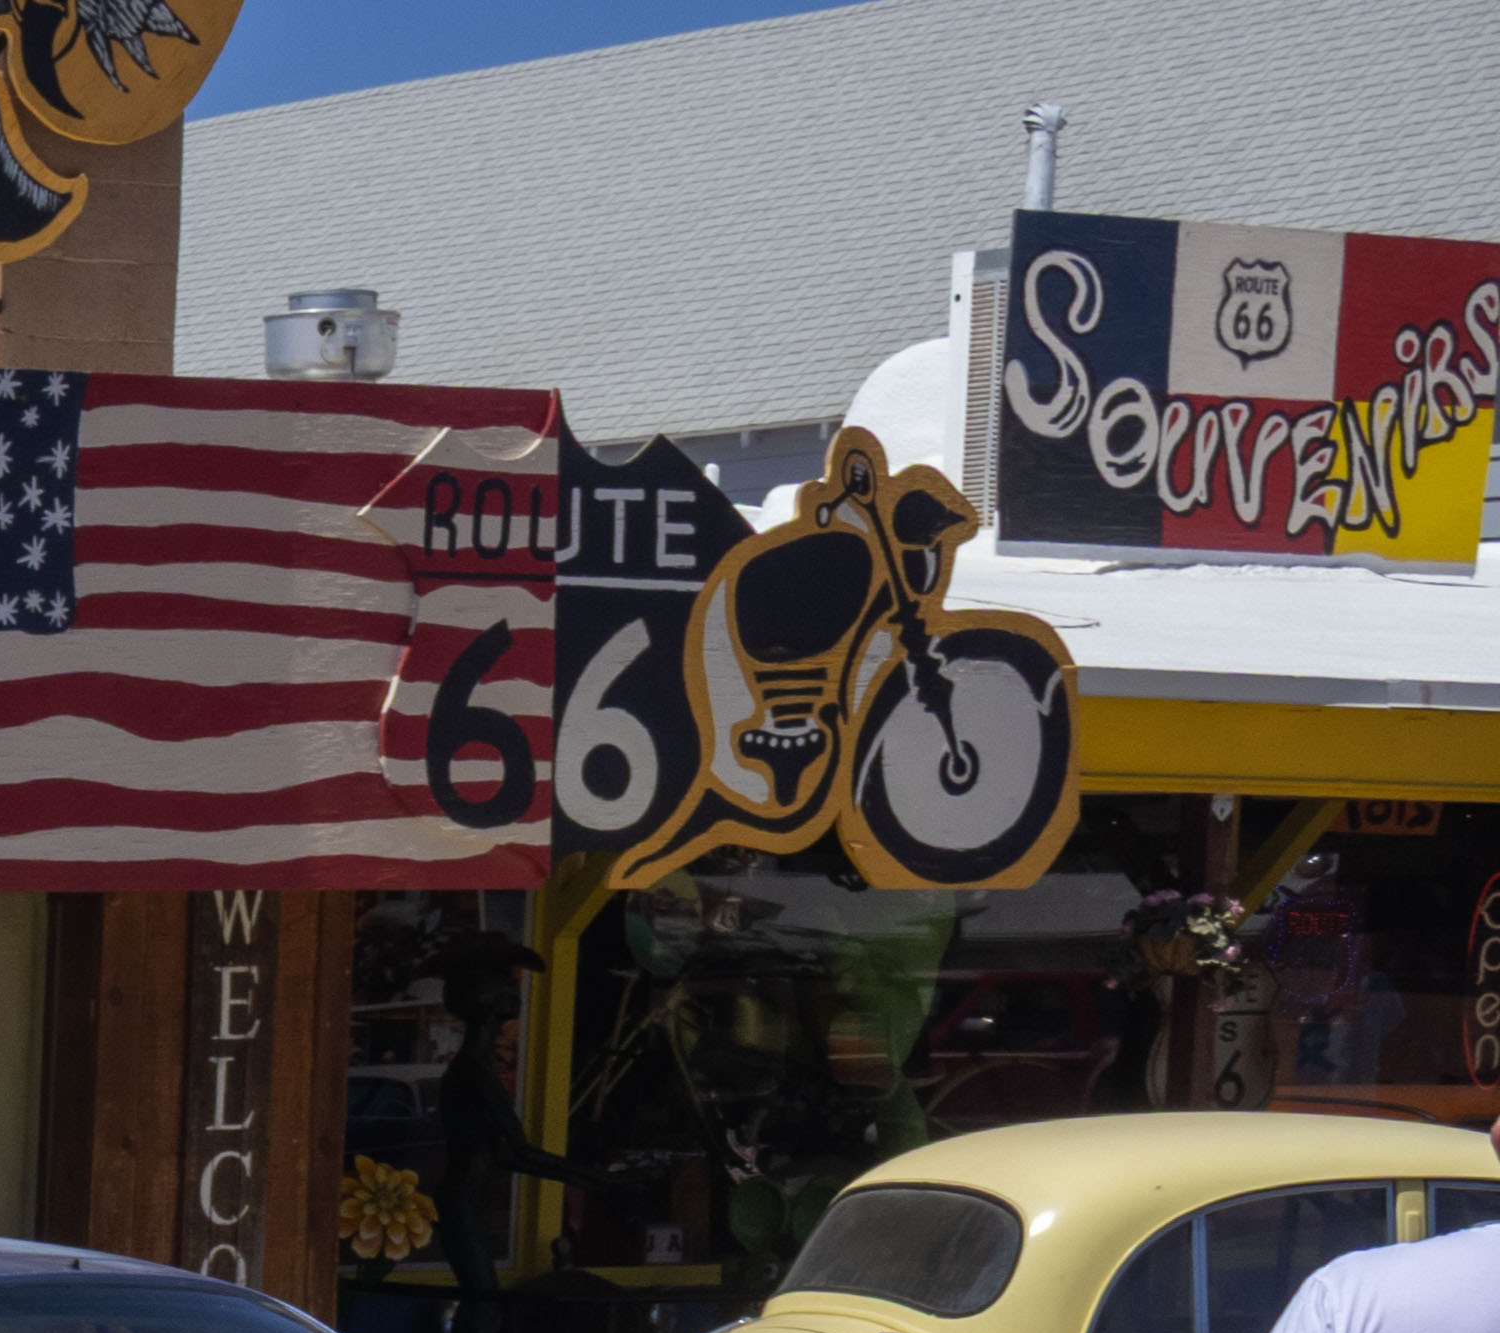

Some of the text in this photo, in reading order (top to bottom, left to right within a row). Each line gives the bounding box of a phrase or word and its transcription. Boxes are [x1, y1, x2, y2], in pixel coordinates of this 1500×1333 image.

[1235, 275, 1279, 296] ROUTE
[1233, 302, 1273, 341] 66
[424, 471, 696, 567] ROUTE
[426, 617, 659, 831] 66
